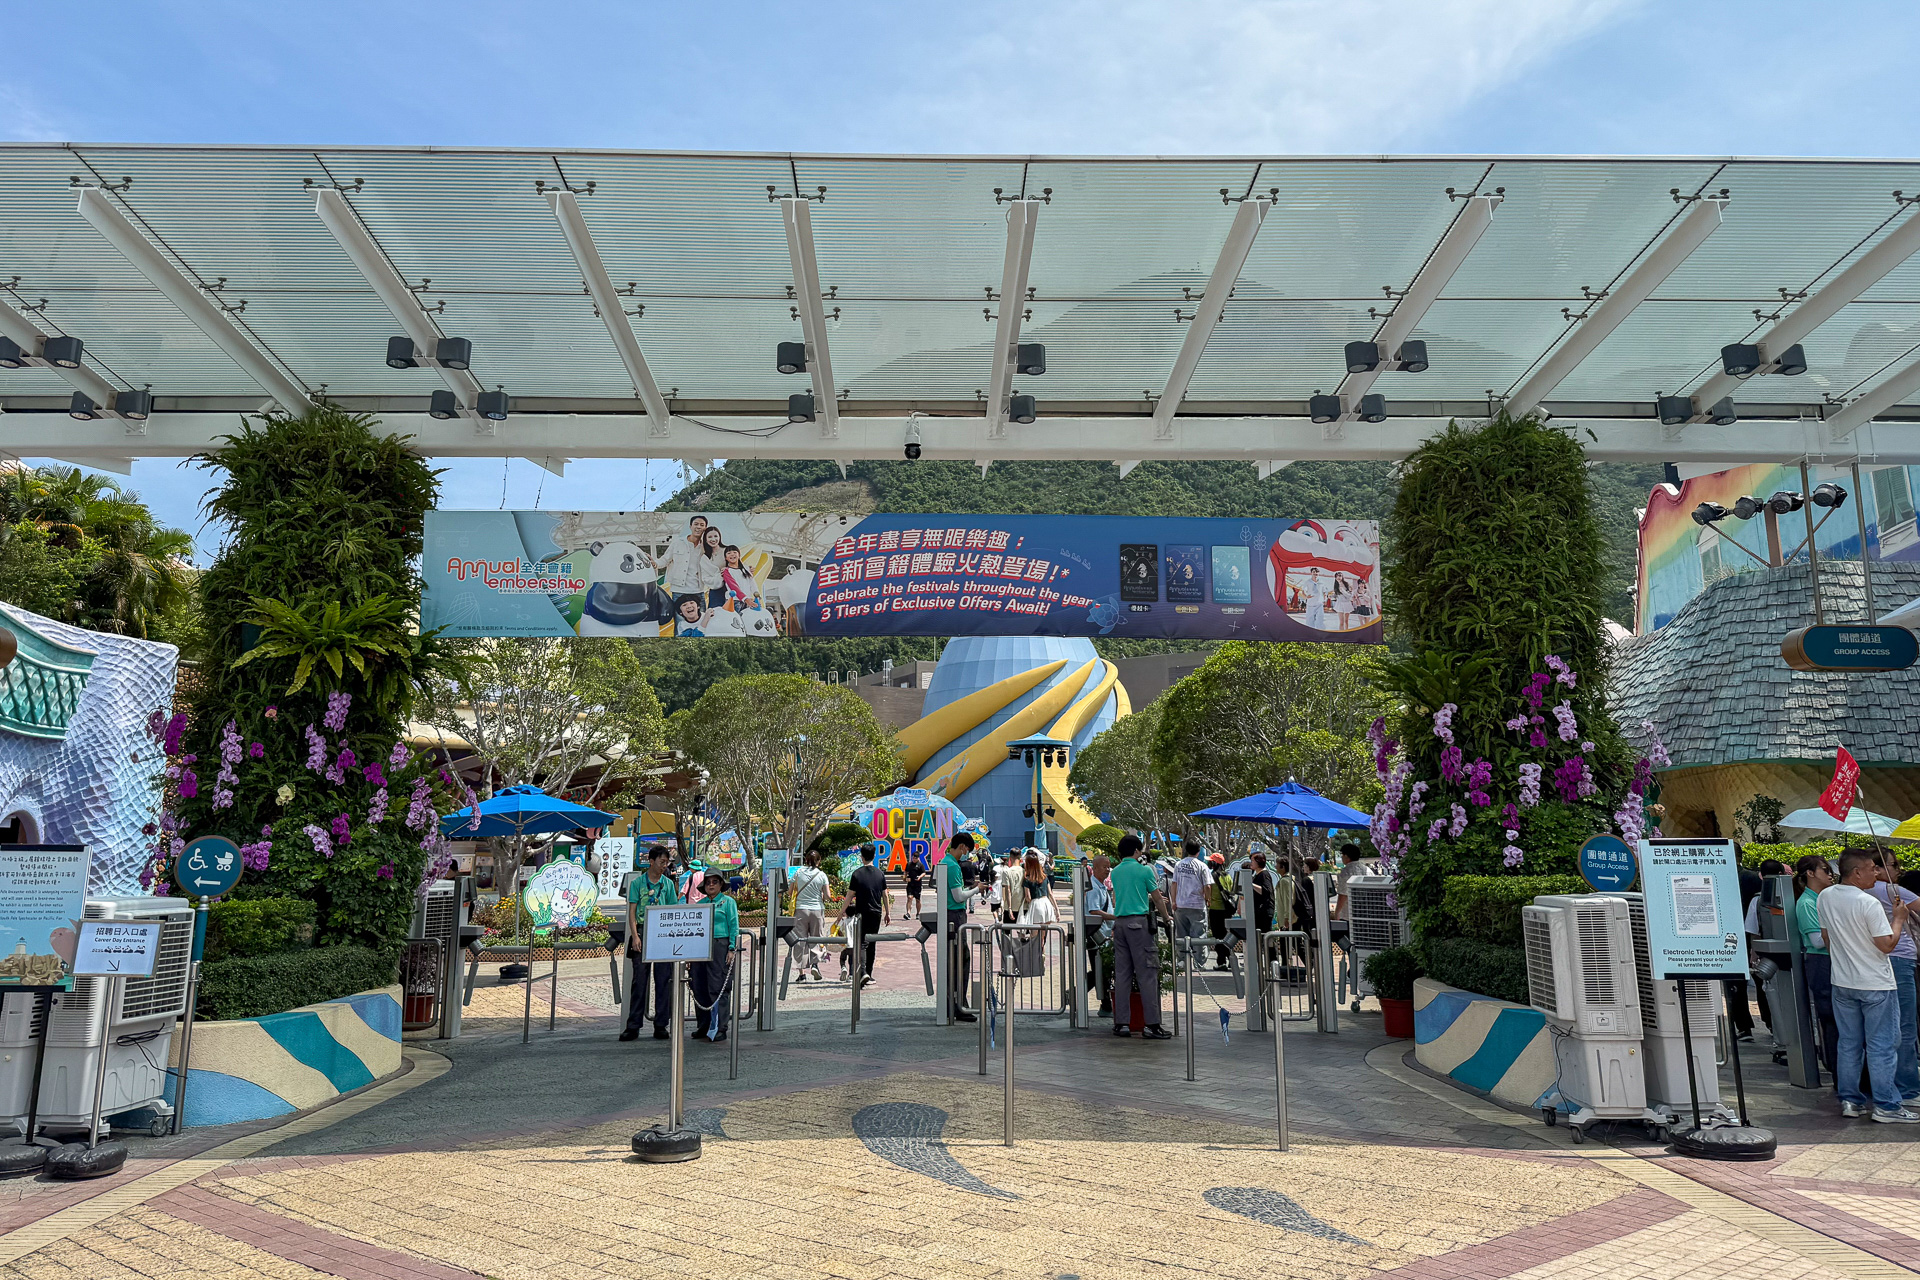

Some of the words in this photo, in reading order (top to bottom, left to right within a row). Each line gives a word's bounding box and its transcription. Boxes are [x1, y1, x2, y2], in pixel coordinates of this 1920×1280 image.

[521, 562, 572, 574] 全年會籍
[817, 586, 879, 605] Celebrate
[883, 583, 904, 596] the
[906, 580, 960, 594] festivals
[963, 581, 1036, 599] throughout
[1039, 587, 1060, 601] the
[1062, 593, 1093, 608] year
[820, 607, 832, 622] 3
[837, 604, 870, 618] Tiers
[874, 600, 889, 613] of
[892, 597, 955, 610] Exclusive
[959, 596, 1002, 611] Offers
[1005, 598, 1051, 615] Await!
[1834, 648, 1860, 656] GROUP
[1861, 648, 1891, 656] ACCESS
[872, 807, 954, 840] OCEAN
[872, 838, 953, 873] PARK
[1587, 849, 1628, 863] 團體通道
[1654, 847, 1724, 857] 已於網上購票人士
[1587, 861, 1606, 870] Group
[1607, 862, 1629, 871] Access
[95, 927, 148, 936] 招聘日入口處
